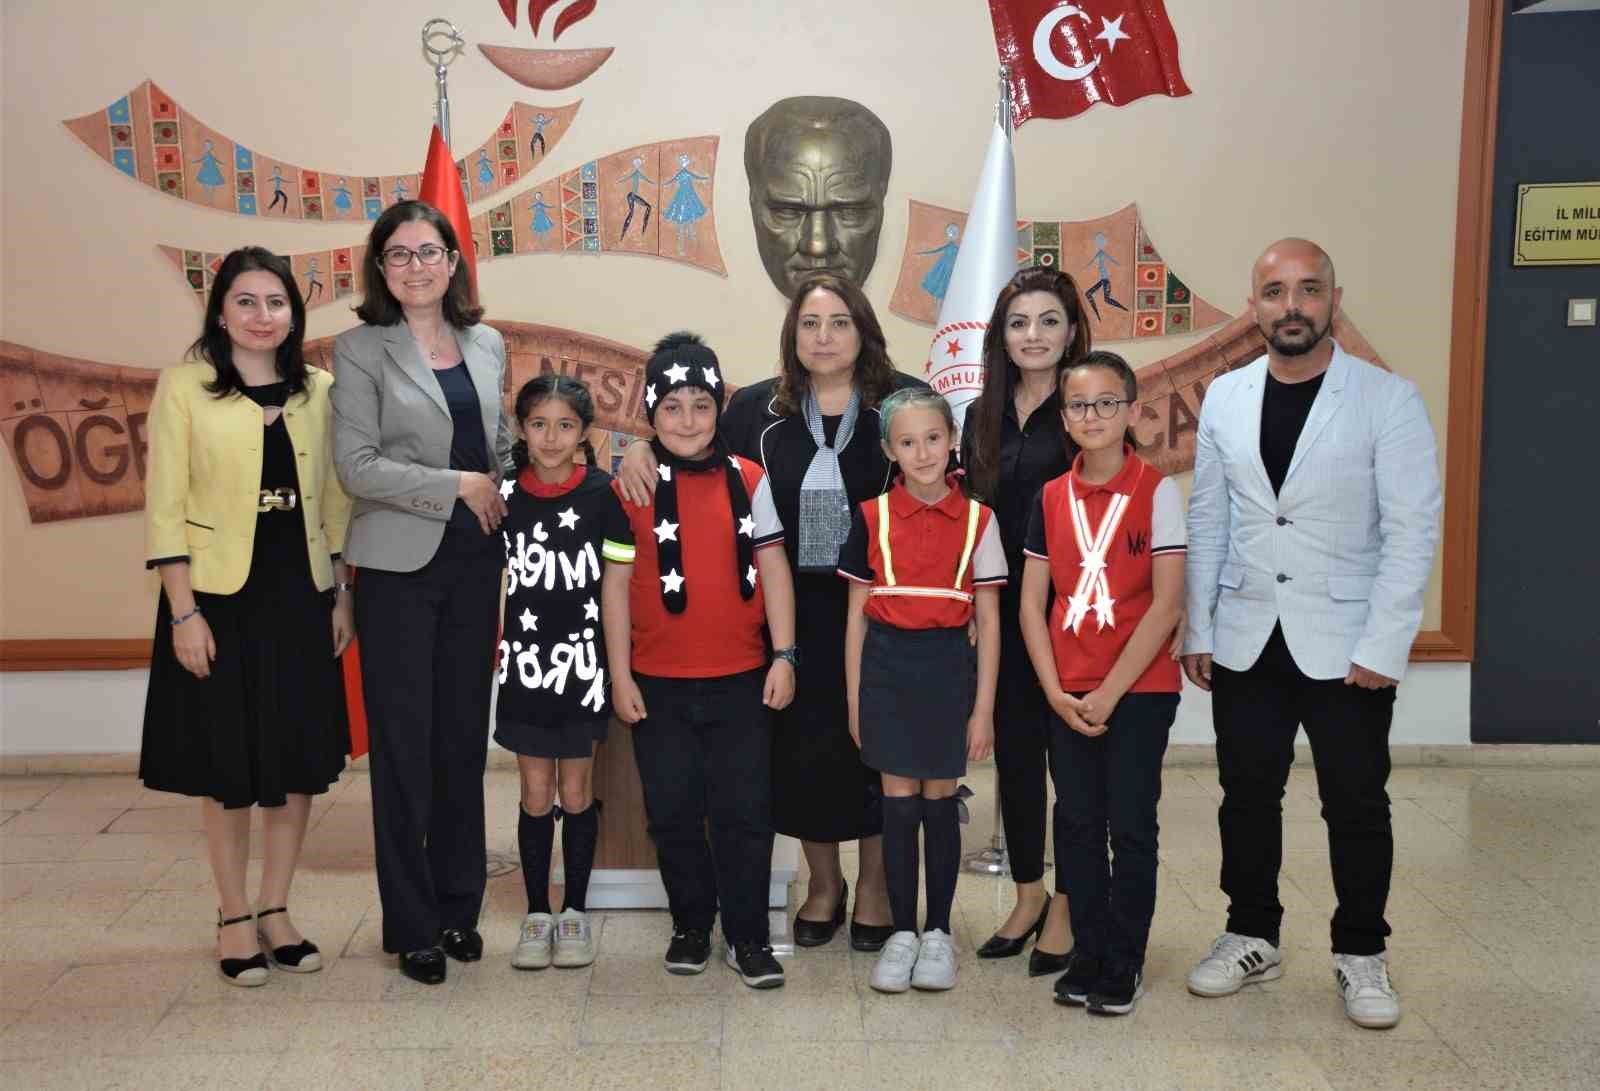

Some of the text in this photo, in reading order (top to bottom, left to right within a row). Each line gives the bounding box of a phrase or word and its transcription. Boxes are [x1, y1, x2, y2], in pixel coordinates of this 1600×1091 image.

[1556, 204, 1568, 220] İL
[1524, 226, 1600, 242] EĞİTİM MÜ
